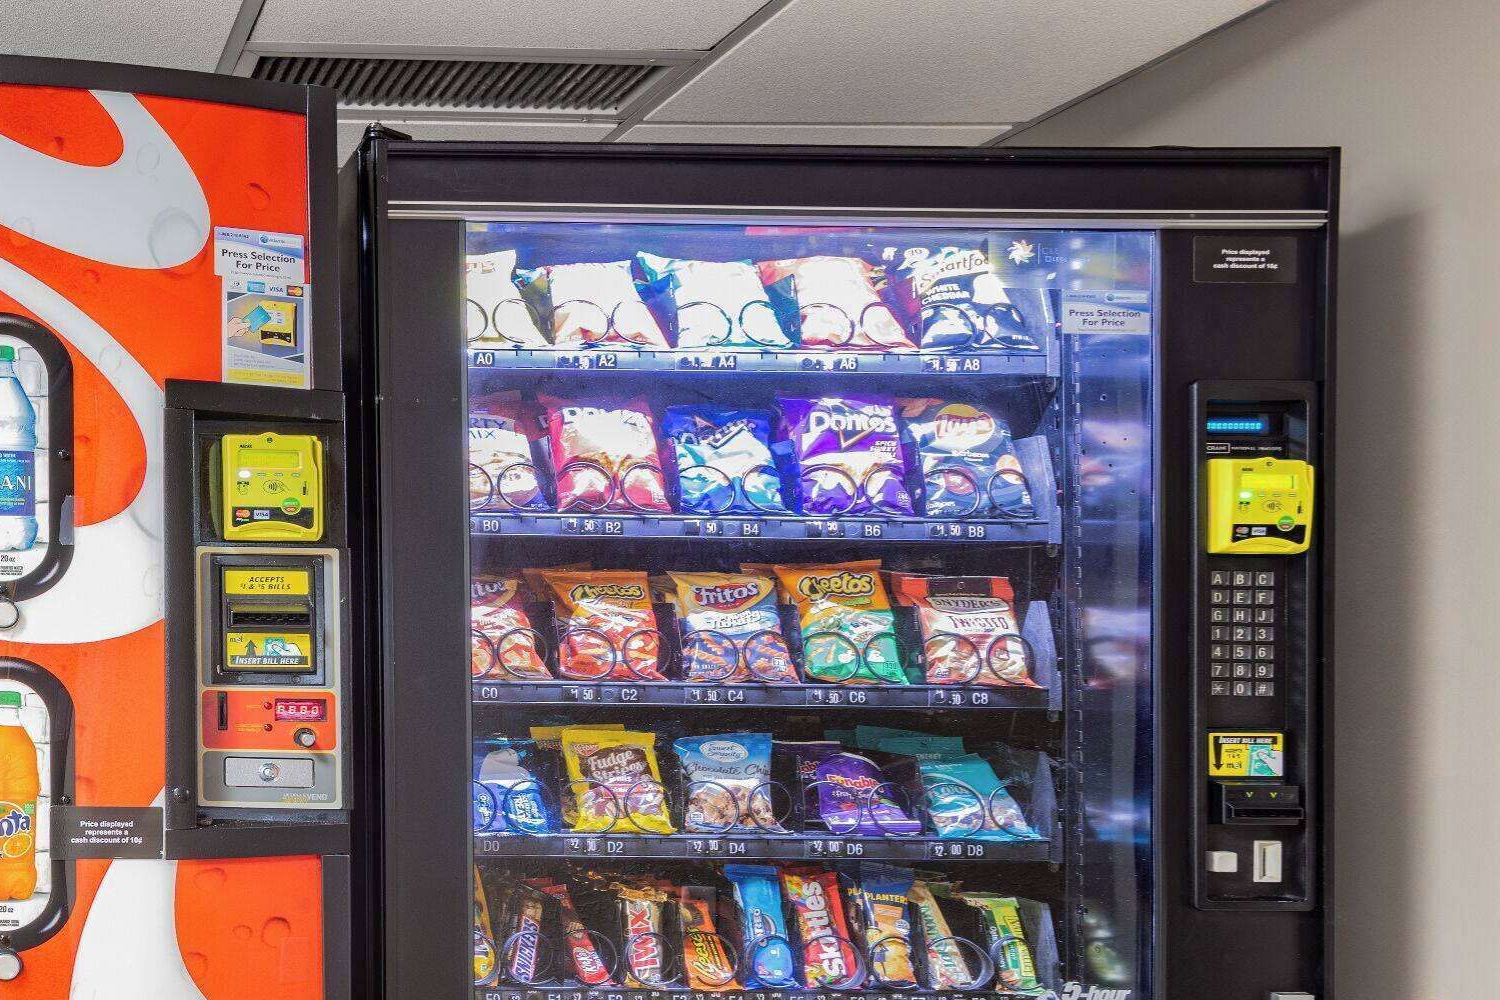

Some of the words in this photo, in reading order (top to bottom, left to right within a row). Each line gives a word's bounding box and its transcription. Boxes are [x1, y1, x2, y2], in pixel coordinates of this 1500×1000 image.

[221, 248, 248, 259] Press
[251, 251, 296, 264] Selection
[236, 260, 252, 269] For
[256, 262, 280, 272] Price
[1069, 309, 1094, 317] Press
[1097, 309, 1141, 318] Selection
[1082, 318, 1099, 326] For
[1101, 318, 1125, 327] Price
[476, 353, 493, 365] A0
[599, 355, 615, 367] A2
[718, 356, 735, 368] A4
[840, 358, 857, 370] A6
[963, 359, 980, 371] A8
[808, 411, 898, 433] Doritos
[483, 520, 499, 532] B0
[605, 521, 622, 534] B2
[743, 523, 760, 535] B4
[864, 524, 881, 537] B6
[968, 525, 985, 538] B8
[0, 554, 9, 563] 20
[1213, 574, 1222, 584] A
[1236, 574, 1244, 584] B
[1259, 574, 1267, 584] C
[798, 571, 875, 602] Cheetos
[690, 582, 759, 606] Fritos
[1213, 592, 1222, 603] D
[1236, 592, 1244, 603] E
[1259, 592, 1267, 603] F
[935, 599, 1001, 609] SNYDER'S
[1213, 610, 1222, 621] G
[1236, 610, 1244, 621] H
[1259, 610, 1267, 621] J
[1216, 628, 1221, 639] 1
[1236, 628, 1244, 639] 2
[1259, 628, 1267, 639] 3
[1213, 647, 1222, 657] 4
[1236, 647, 1244, 657] 5
[1259, 647, 1267, 657] 6
[235, 656, 261, 665] INSERT
[262, 656, 279, 665] BILL
[280, 657, 300, 665] HERE
[1213, 665, 1222, 676] 7
[1236, 665, 1244, 676] 8
[1259, 665, 1267, 676] 9
[481, 687, 498, 699] C0
[621, 688, 638, 701] C2
[1236, 684, 1244, 694] 0
[727, 690, 744, 702] C4
[849, 691, 866, 703] C6
[972, 692, 989, 705] C8
[1219, 736, 1241, 744] INSERT
[588, 750, 633, 771] Fudge
[684, 760, 741, 776] Chocolate
[79, 820, 99, 828] Price
[99, 820, 134, 829] displayed
[70, 836, 88, 844] cash
[89, 836, 121, 844] discount
[121, 836, 129, 844] of
[483, 840, 500, 852] D0
[607, 841, 624, 853] D2
[728, 842, 746, 854] D4
[846, 843, 864, 855] D6
[967, 844, 984, 856] D8
[802, 881, 846, 977] Skittles
[629, 907, 660, 970] TWIX
[514, 917, 540, 983] SNICKERS
